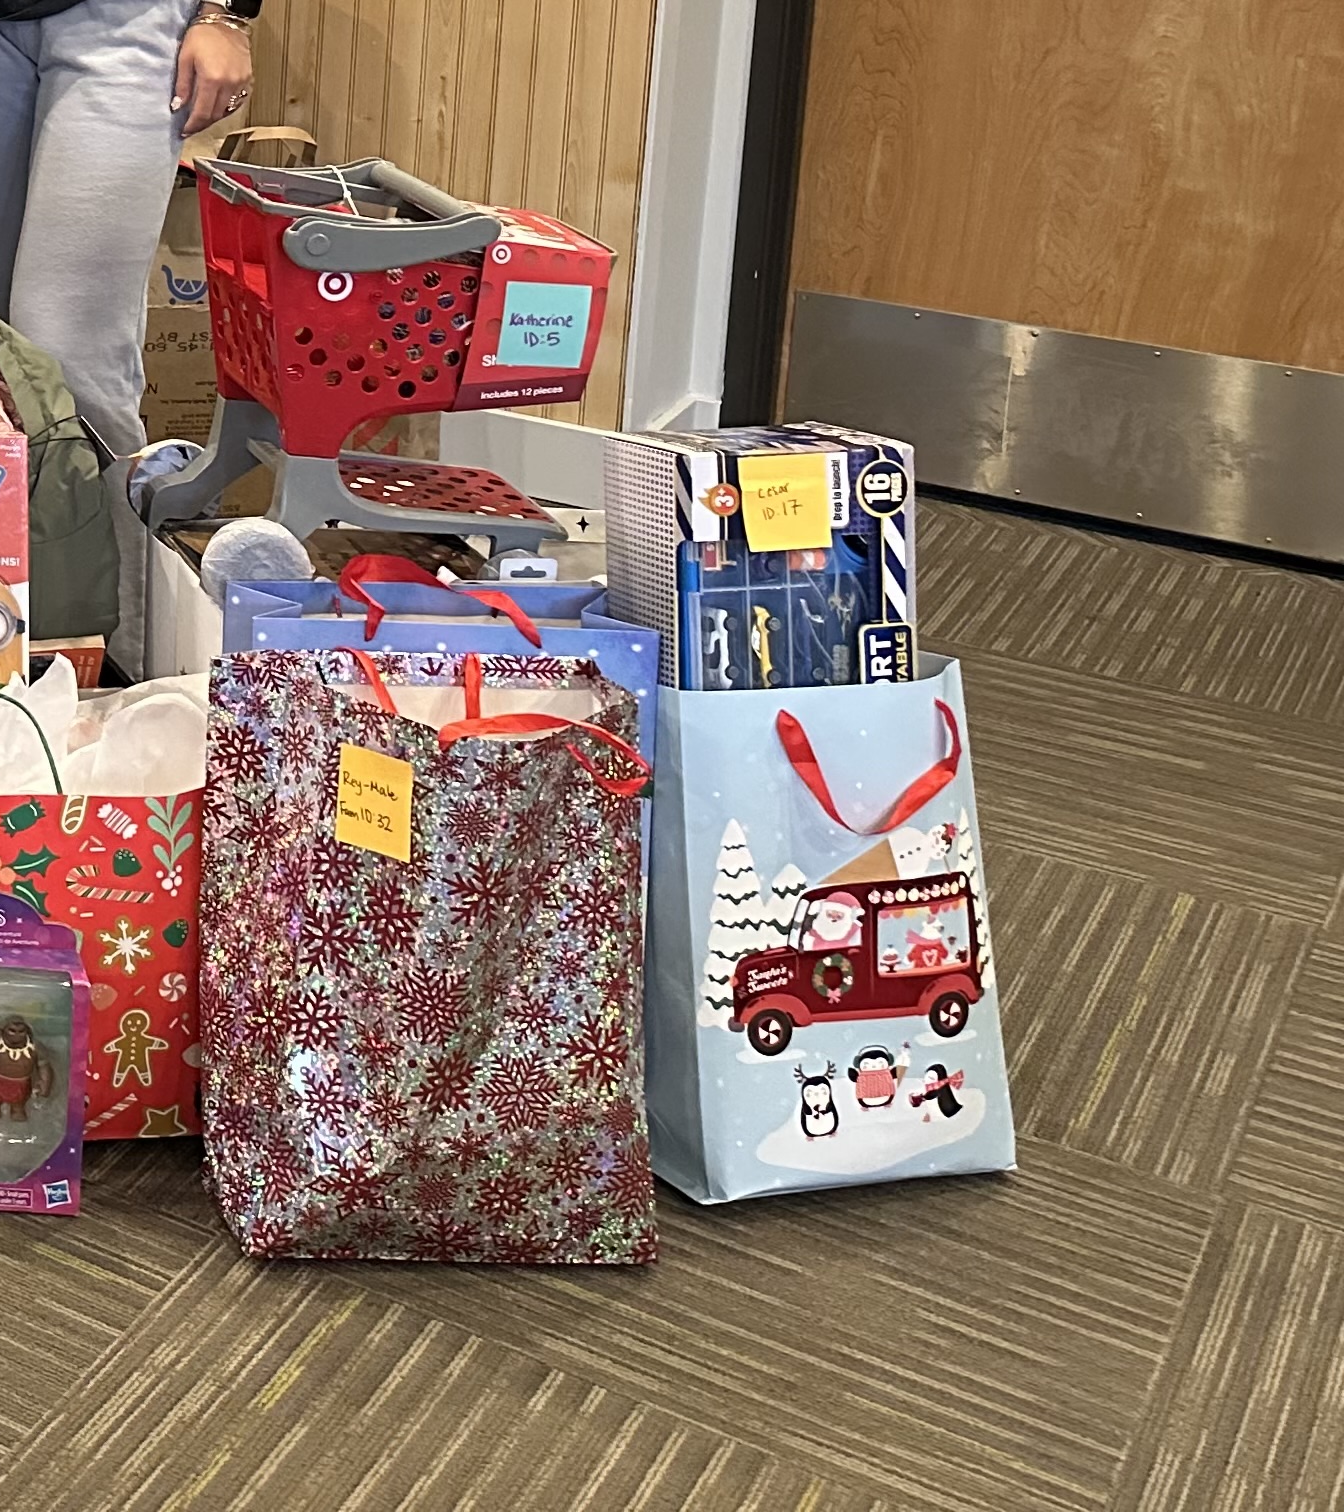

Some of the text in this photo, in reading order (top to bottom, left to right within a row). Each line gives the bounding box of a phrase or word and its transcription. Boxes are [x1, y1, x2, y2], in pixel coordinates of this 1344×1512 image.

[509, 312, 573, 328] Katherine
[481, 386, 563, 400] Includes 12 pieces
[715, 487, 734, 507] 3+
[864, 473, 891, 504] 16
[377, 814, 393, 832] 32
